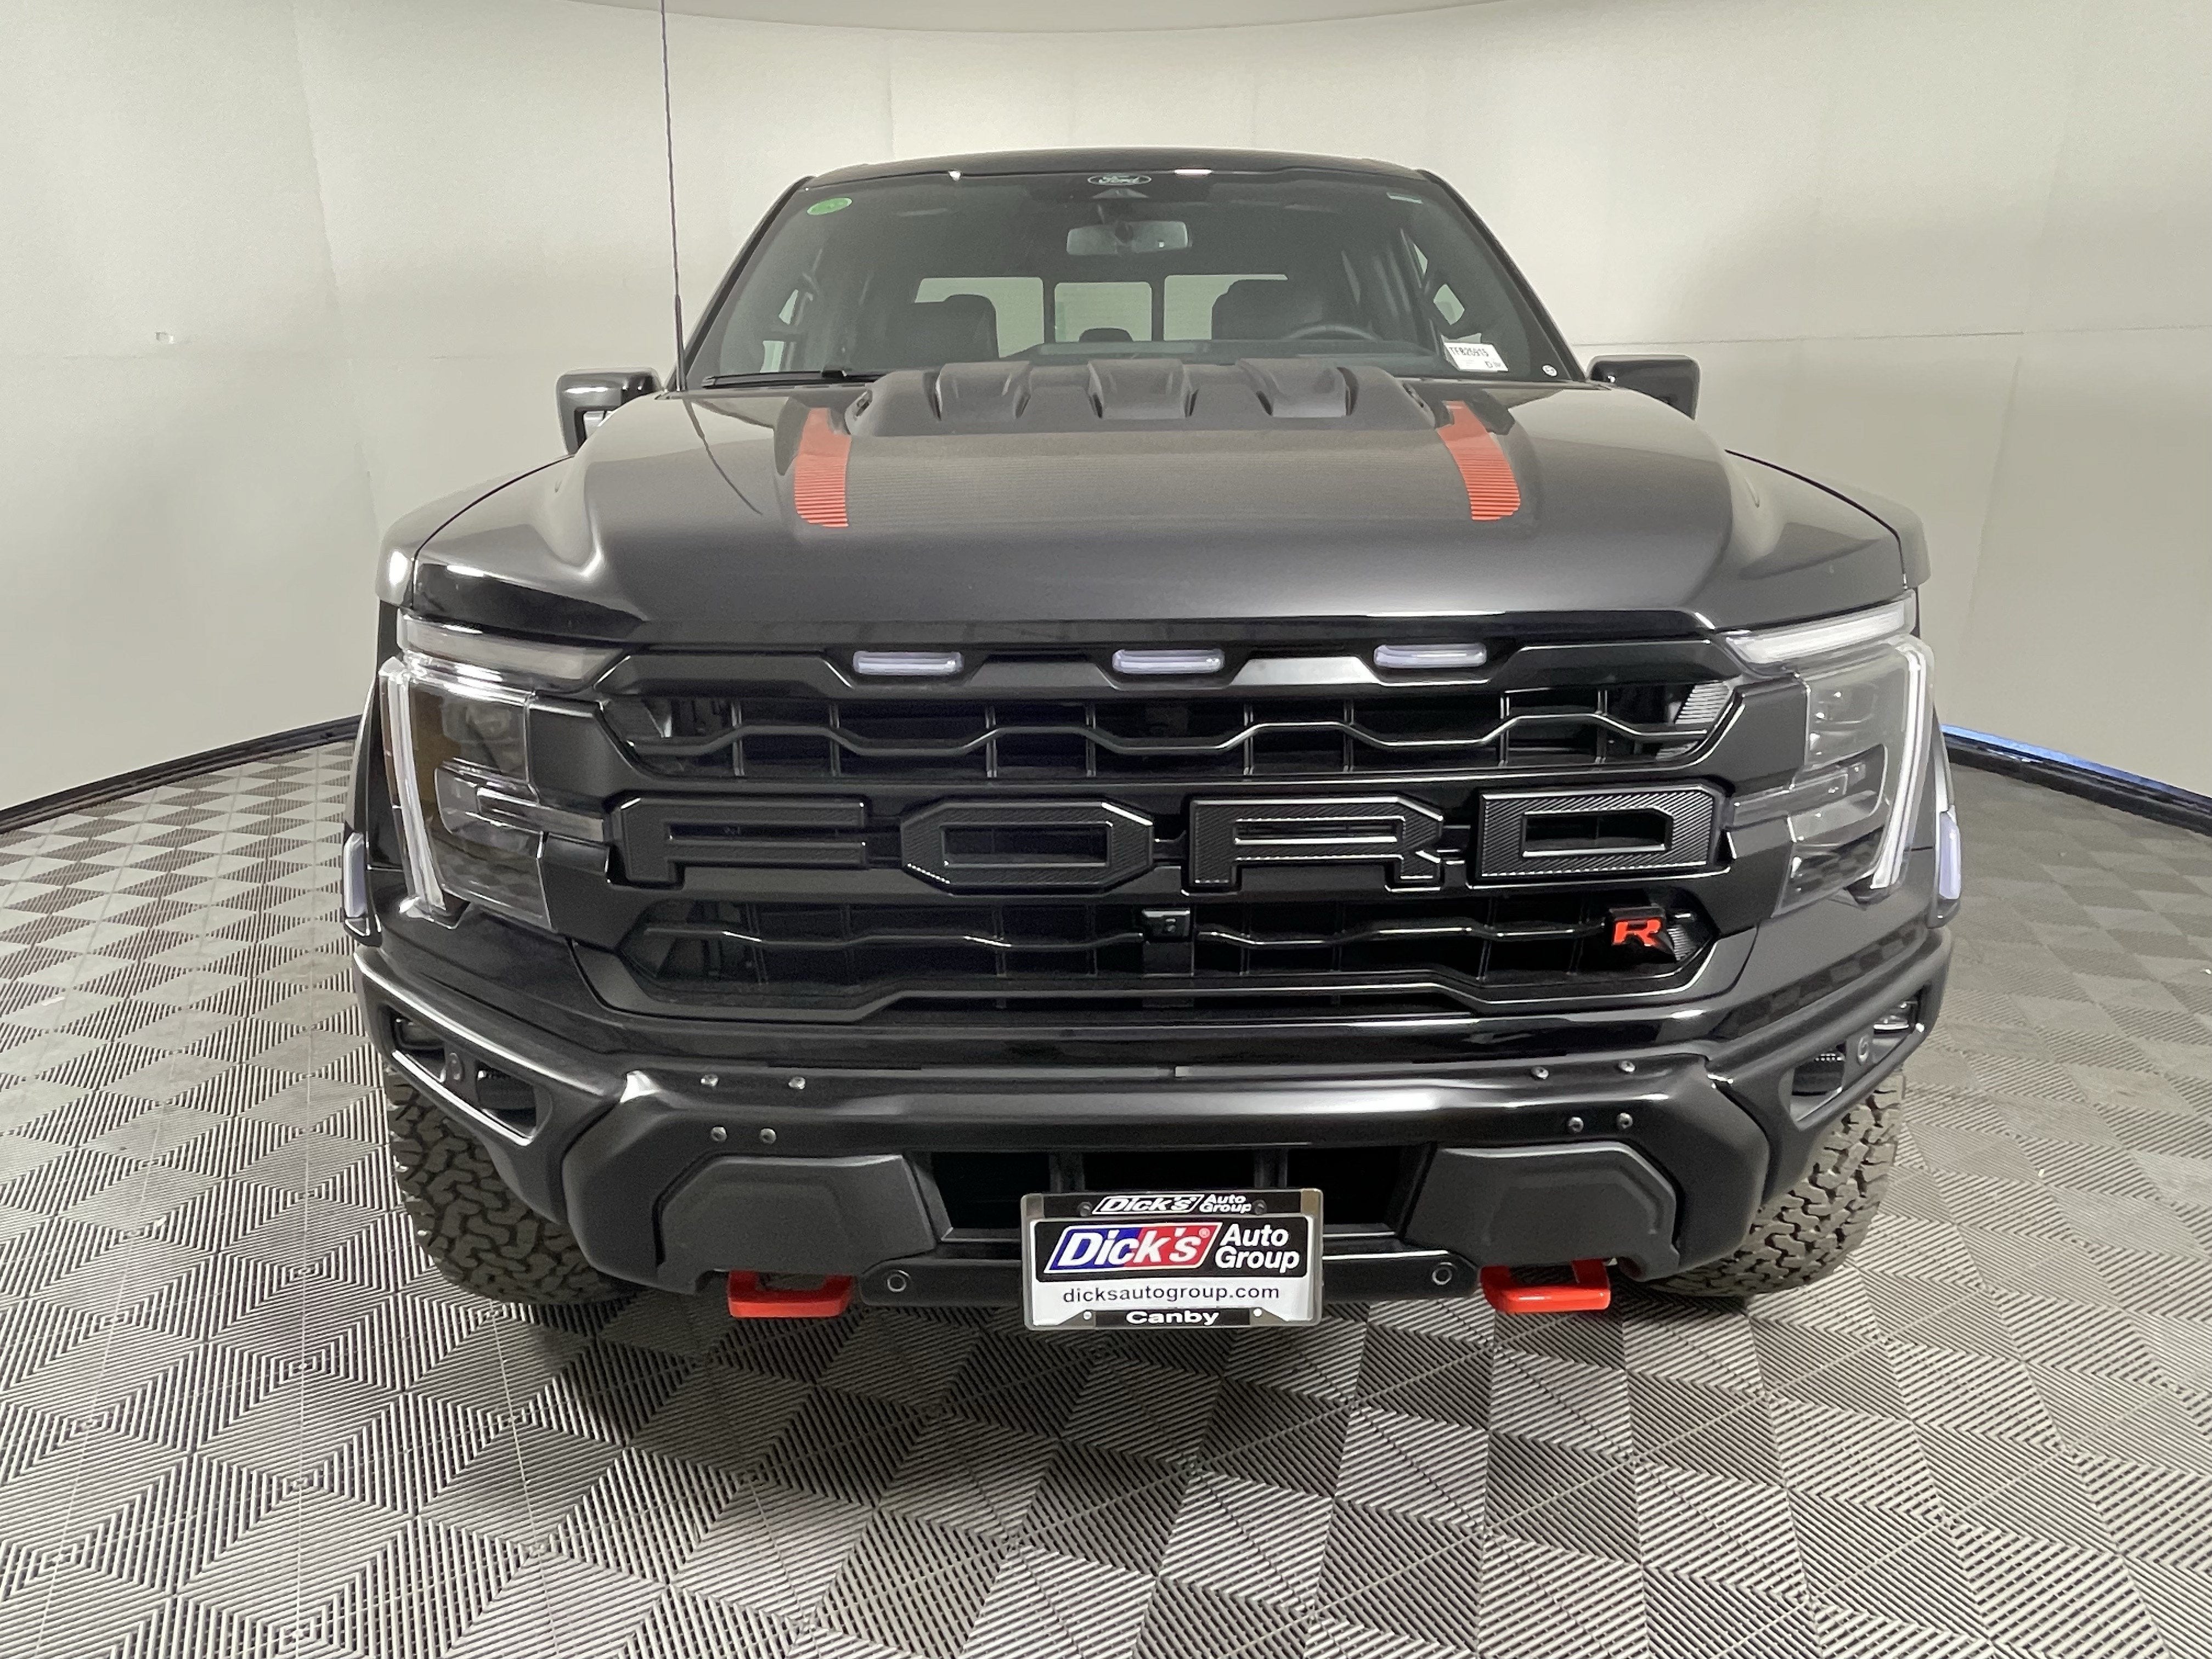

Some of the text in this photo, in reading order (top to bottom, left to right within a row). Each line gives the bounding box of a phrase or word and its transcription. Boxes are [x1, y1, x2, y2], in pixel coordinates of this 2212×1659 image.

[619, 786, 1716, 886] FORD
[1612, 918, 1661, 947] R
[1099, 1197, 1192, 1212] Dick's
[1199, 1202, 1252, 1214] Group
[1204, 1194, 1247, 1204] Auto
[1220, 1223, 1289, 1248] Auto
[1057, 1227, 1202, 1267] Dick's
[1215, 1246, 1300, 1273] Group
[1062, 1286, 1280, 1304] dicksautogroup.com
[1125, 1309, 1219, 1325] Canby
